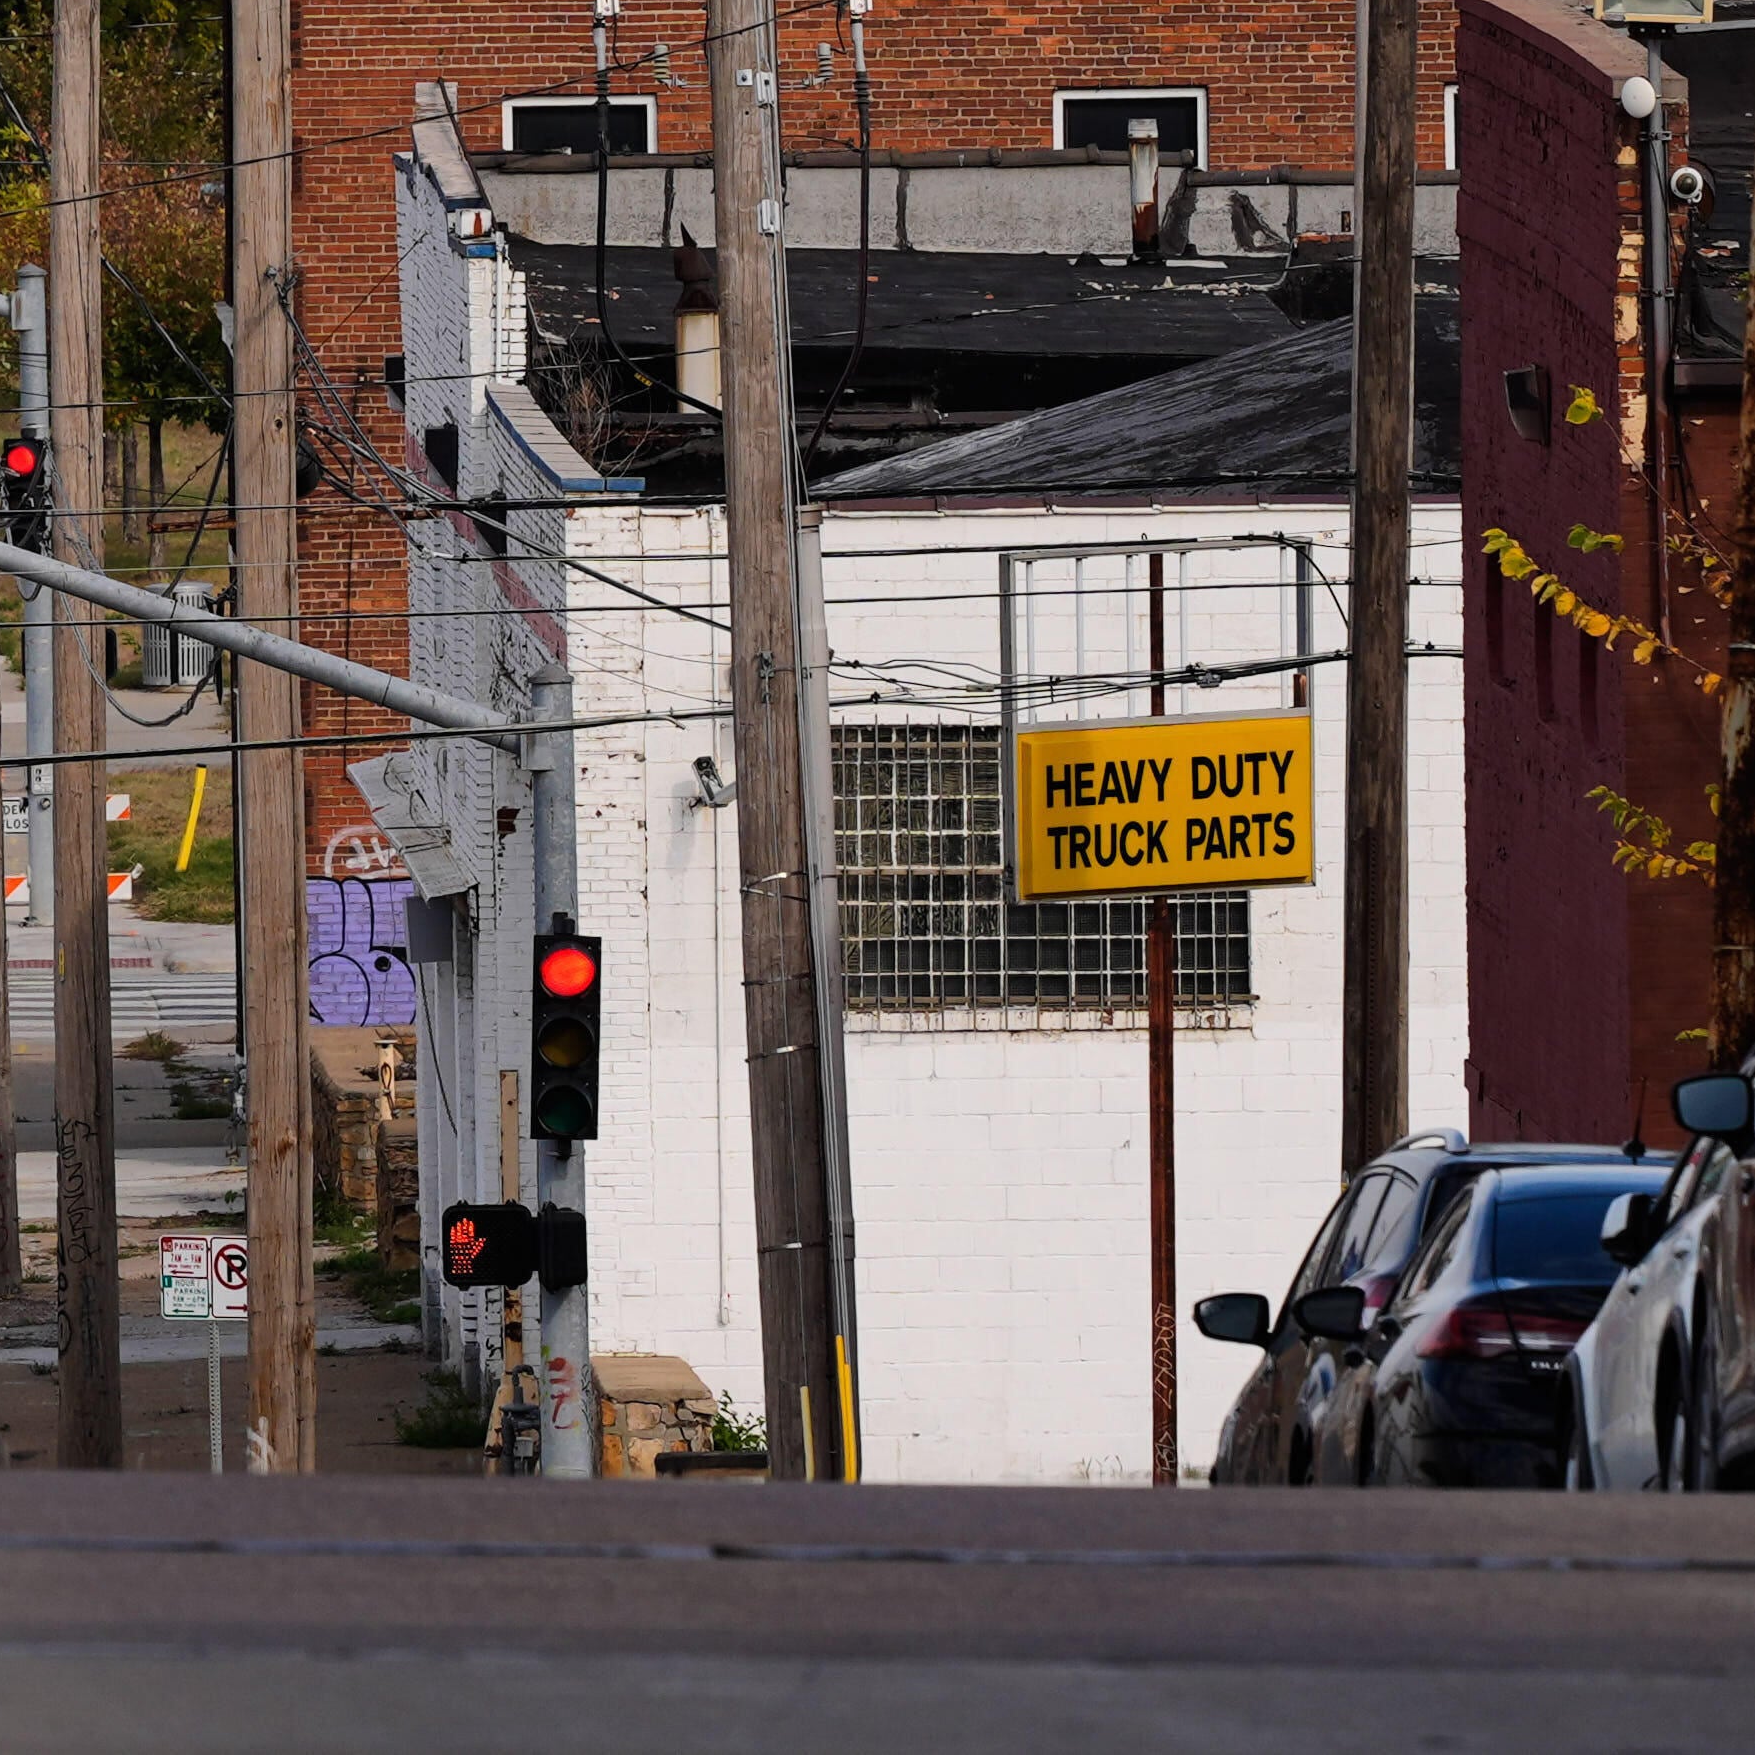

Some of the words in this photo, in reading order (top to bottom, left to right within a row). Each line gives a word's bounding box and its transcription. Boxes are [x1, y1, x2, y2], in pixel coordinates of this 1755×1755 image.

[1046, 757, 1173, 808] HEAVY
[1191, 750, 1294, 800] DUTY
[1047, 820, 1169, 870] TRUCK
[1186, 811, 1295, 862] PARTS
[174, 1243, 204, 1251] PARKING
